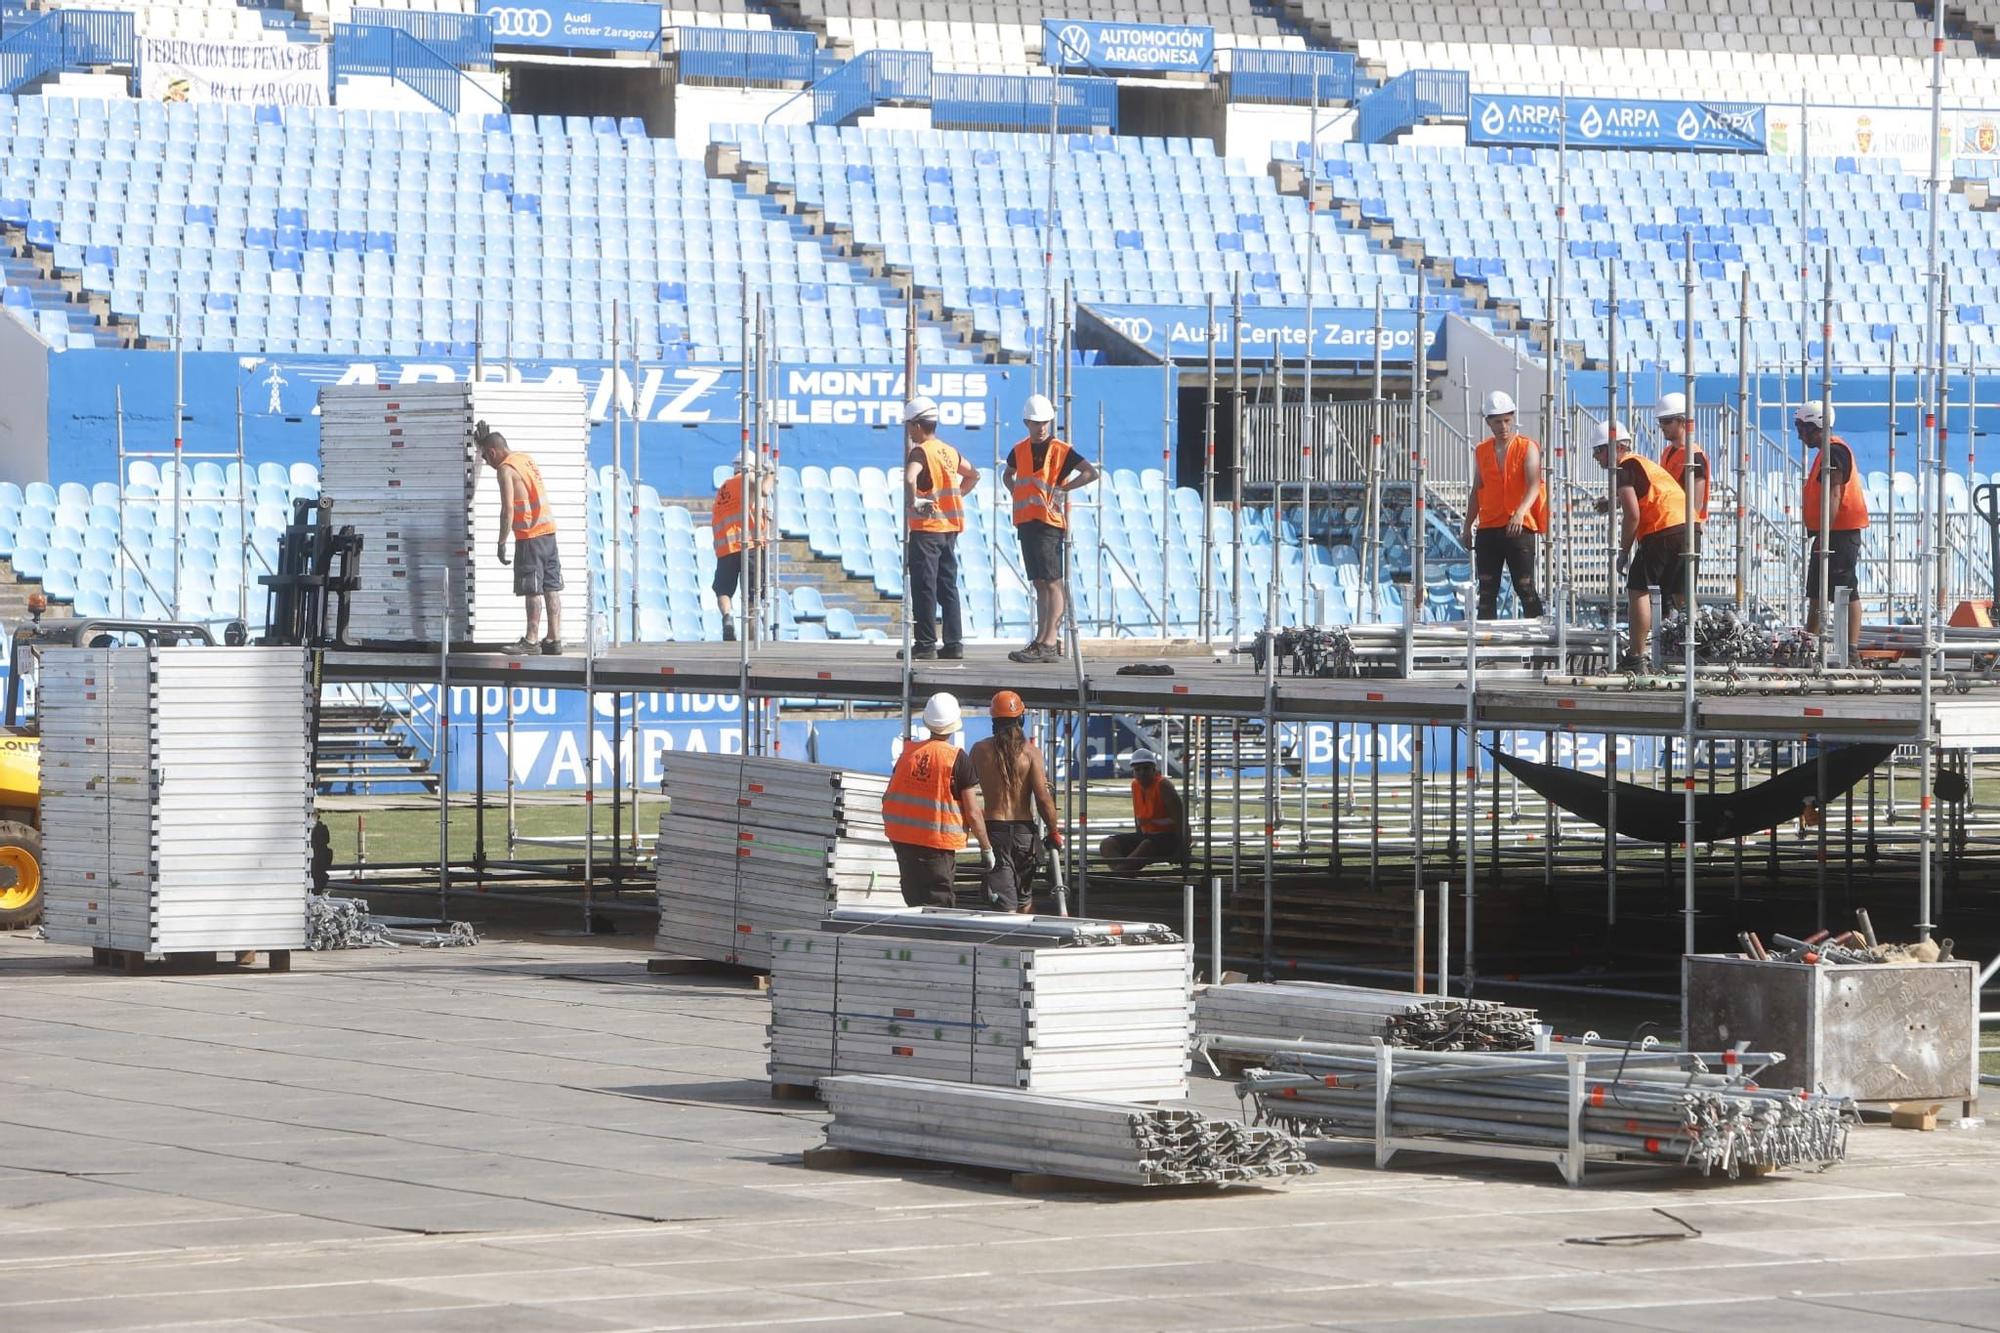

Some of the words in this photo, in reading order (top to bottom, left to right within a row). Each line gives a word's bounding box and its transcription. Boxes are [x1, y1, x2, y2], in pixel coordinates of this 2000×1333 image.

[564, 12, 591, 23] Audi
[564, 26, 601, 36] Center
[604, 27, 655, 40] Zaragoza
[1100, 27, 1204, 48] AUTOMOCIÓN
[1105, 47, 1199, 65] ARAGONESA
[1507, 104, 1561, 125] ARPA
[1605, 108, 1660, 128] ARPA
[1171, 321, 1228, 343] Audi
[1238, 323, 1317, 344] Center
[767, 399, 986, 426] ELECTROS
